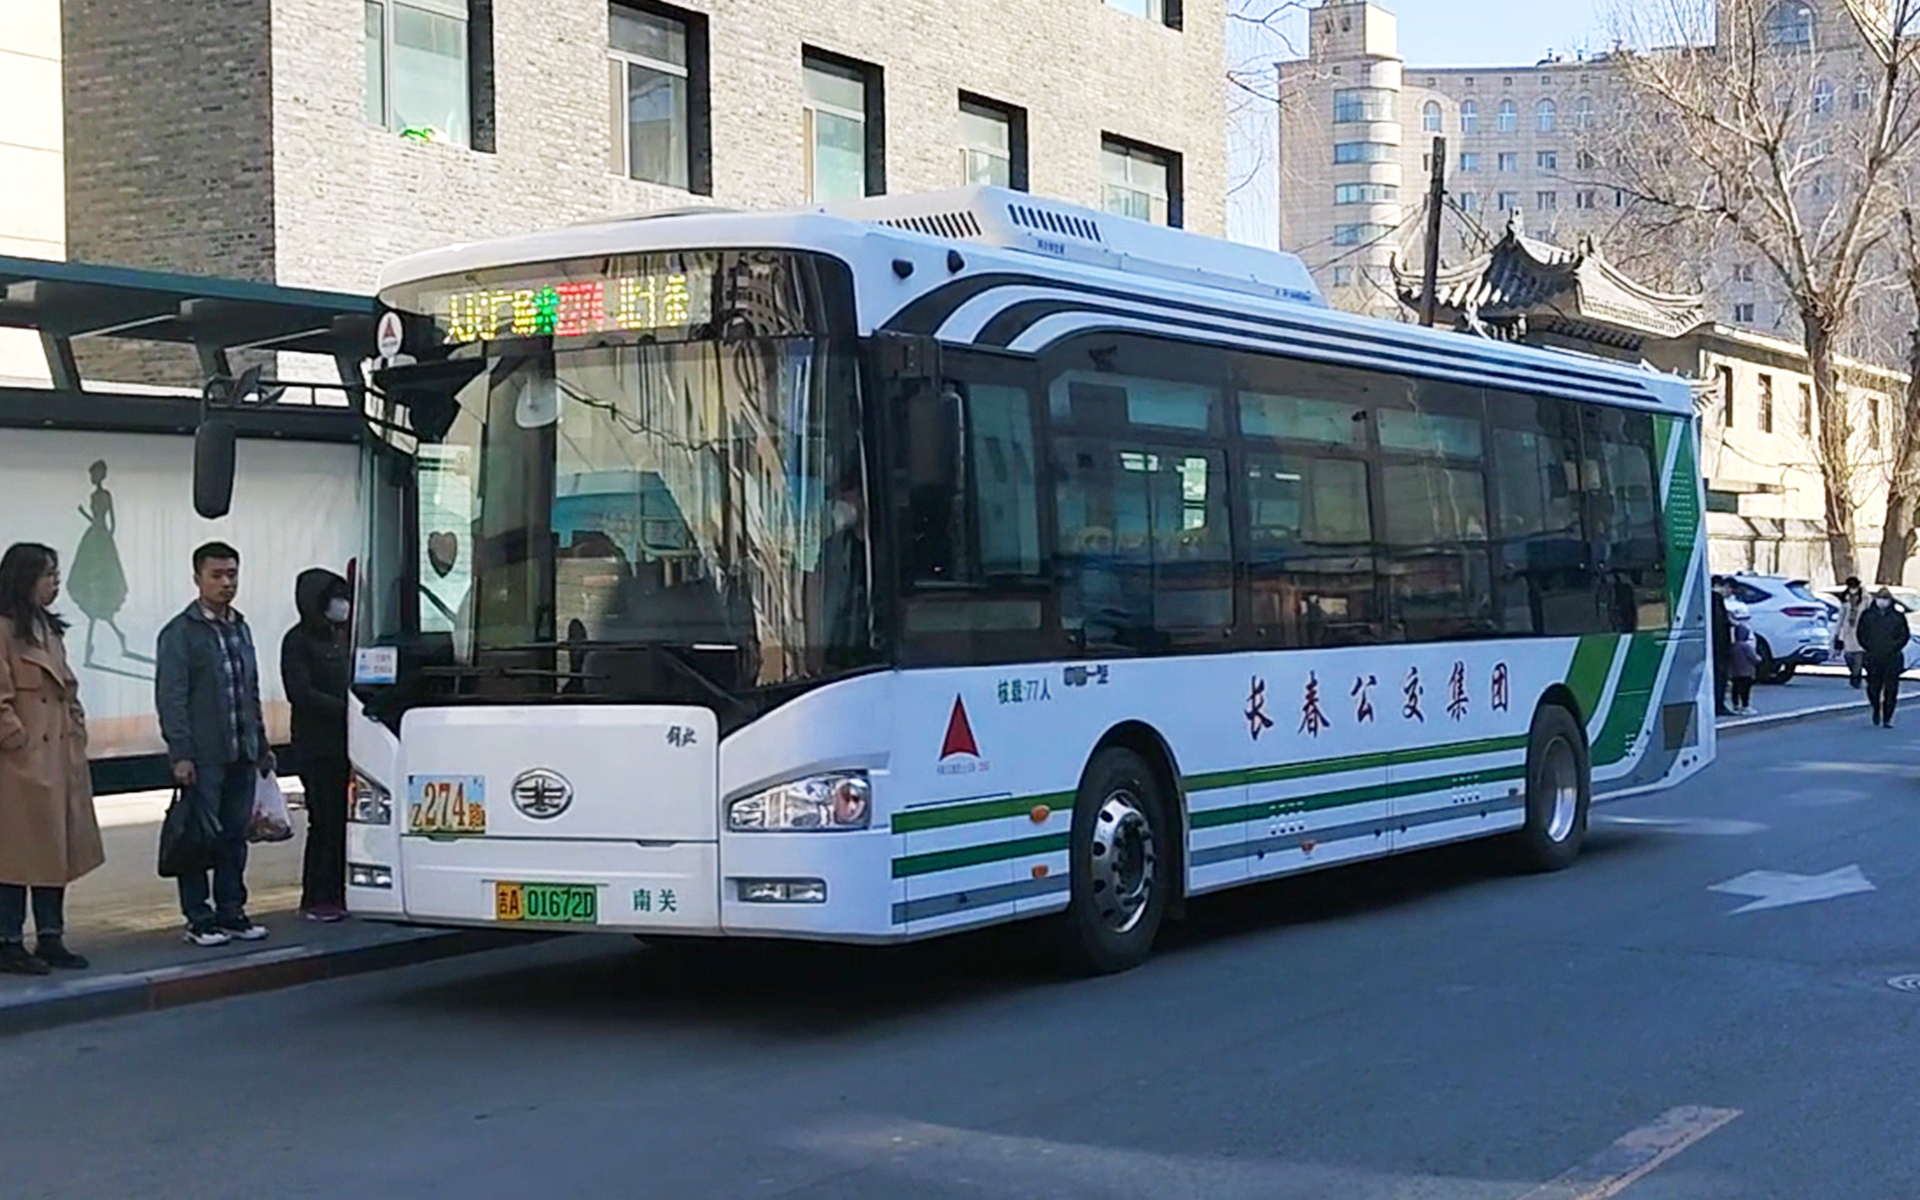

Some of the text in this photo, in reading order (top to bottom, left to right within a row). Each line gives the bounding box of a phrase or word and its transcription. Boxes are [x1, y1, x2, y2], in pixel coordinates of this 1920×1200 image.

[1244, 660, 1508, 741] 长春公交集团
[632, 888, 677, 913] 南关
